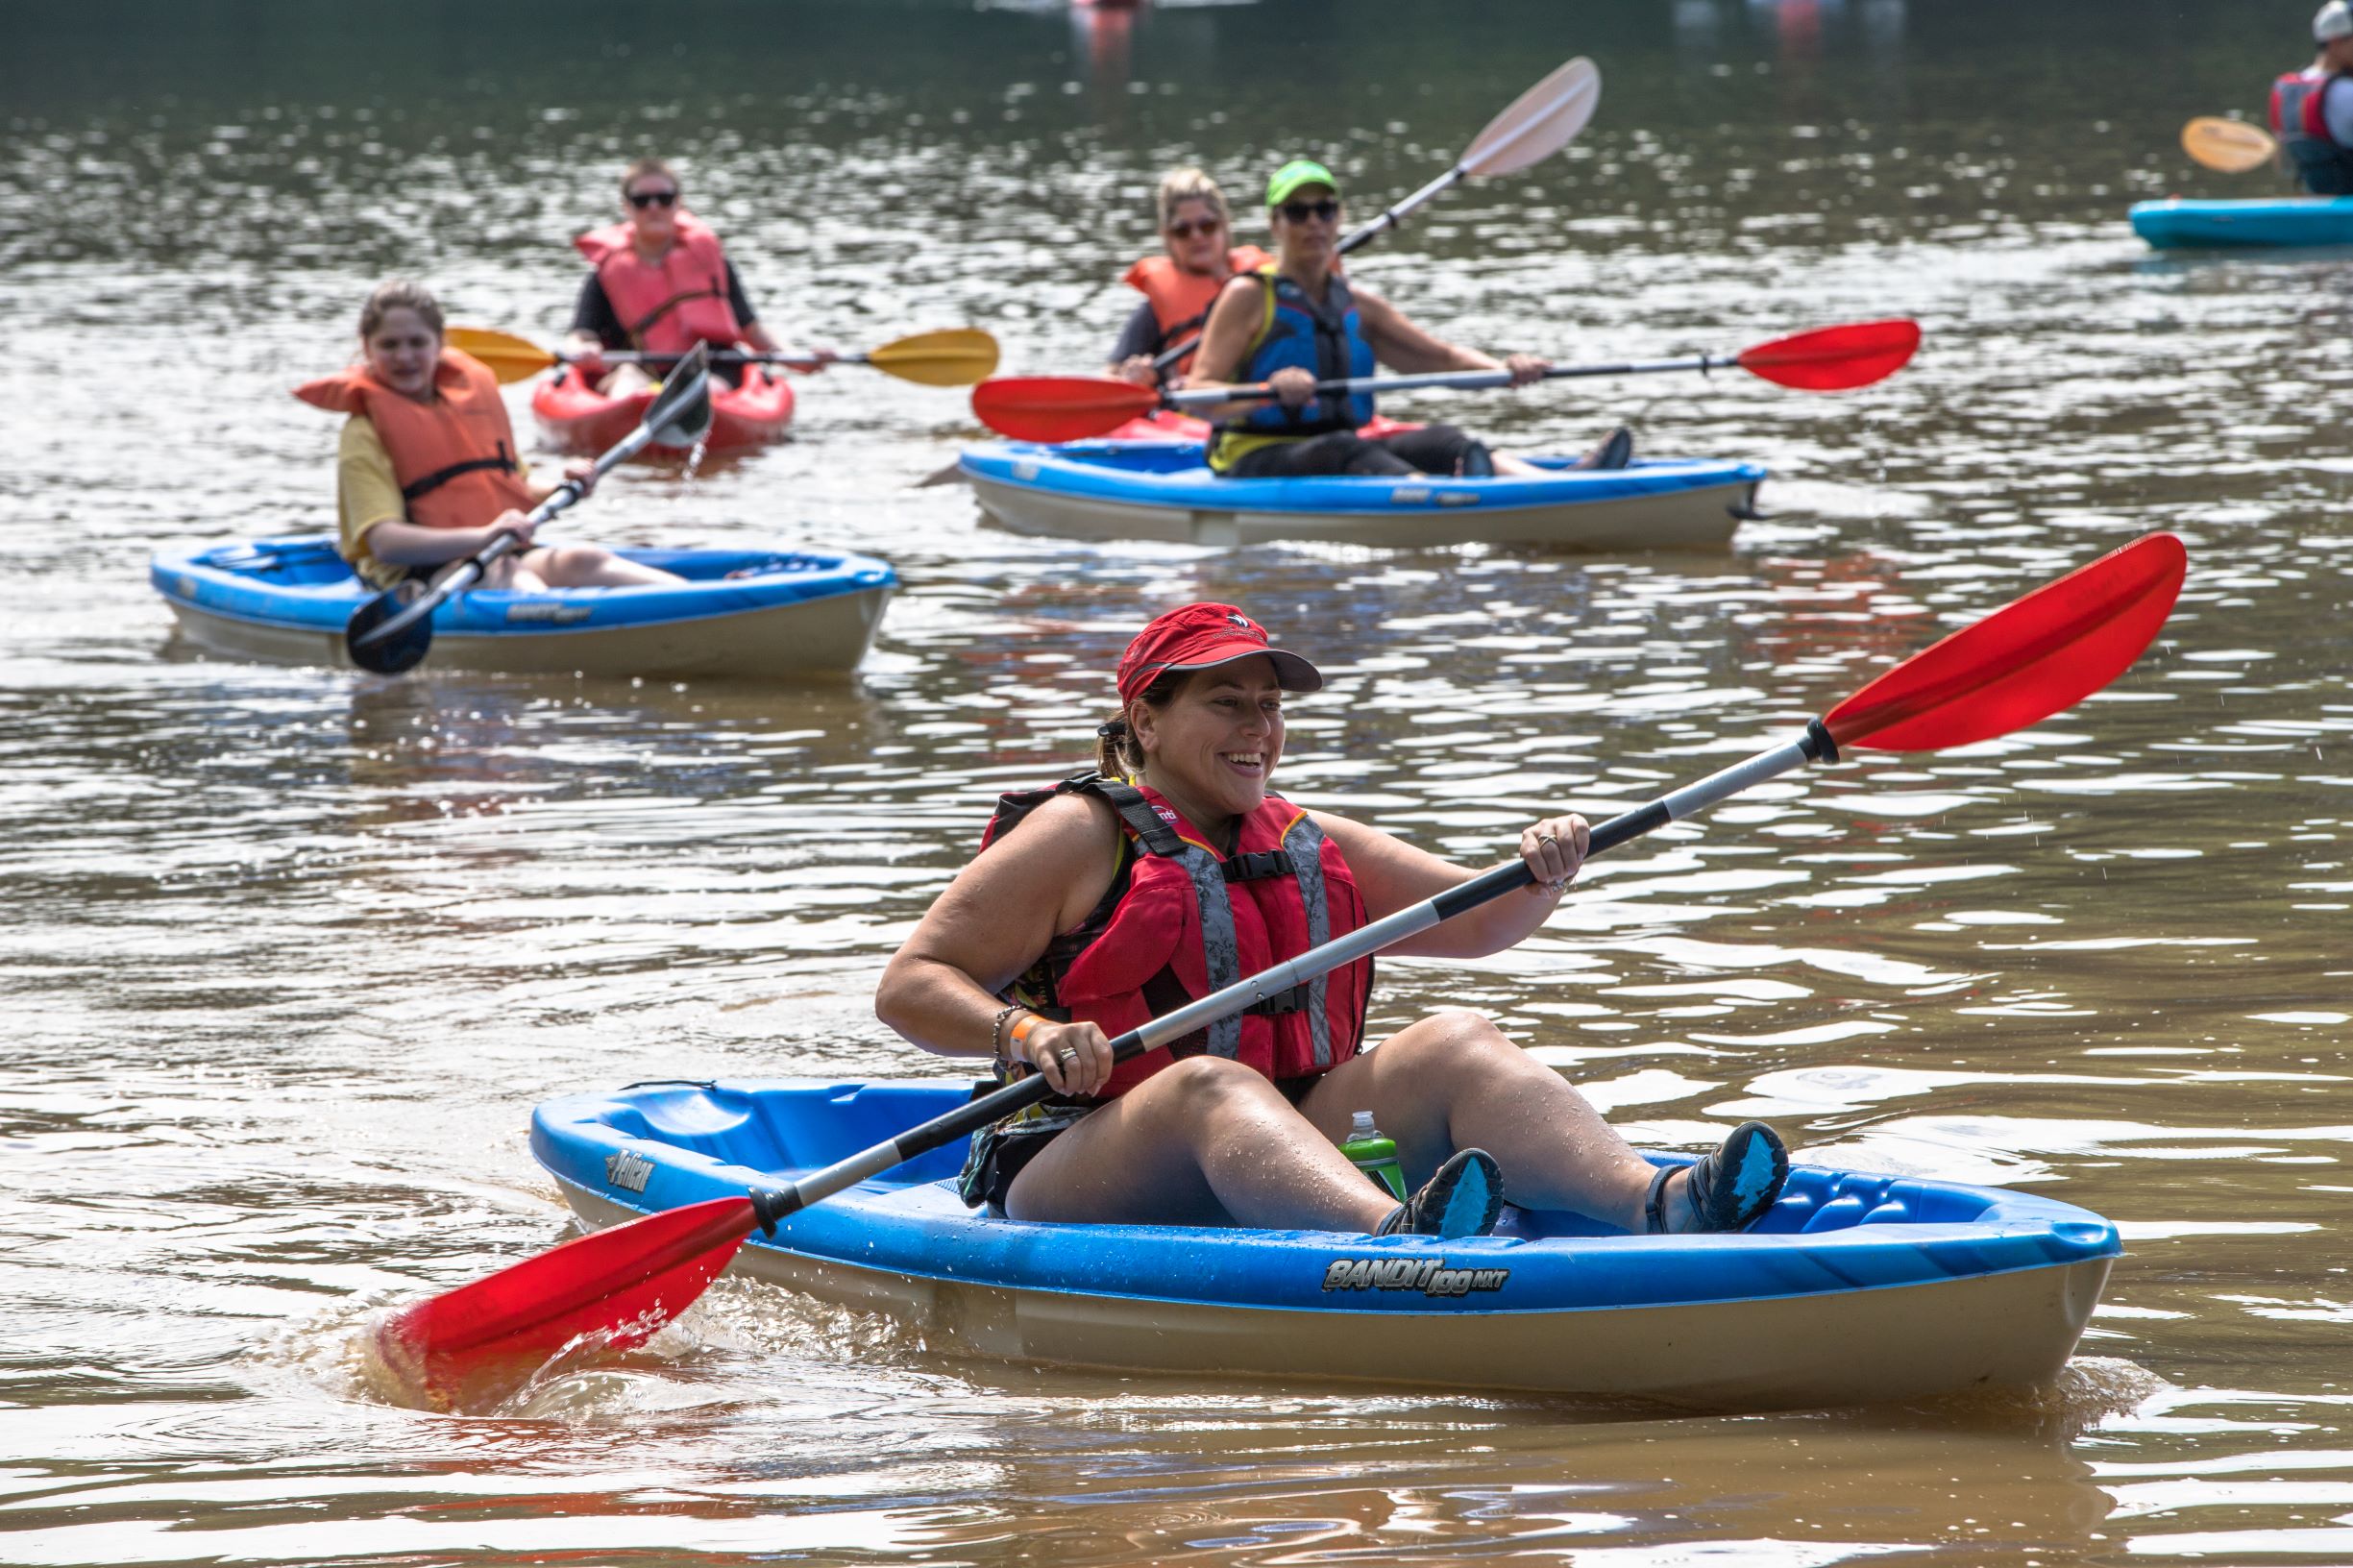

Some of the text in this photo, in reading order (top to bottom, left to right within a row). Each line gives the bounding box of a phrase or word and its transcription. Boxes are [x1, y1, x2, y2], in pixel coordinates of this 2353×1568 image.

[609, 1149, 655, 1191] Pelican
[1323, 1258, 1508, 1295] BANDIT 100 NXT
